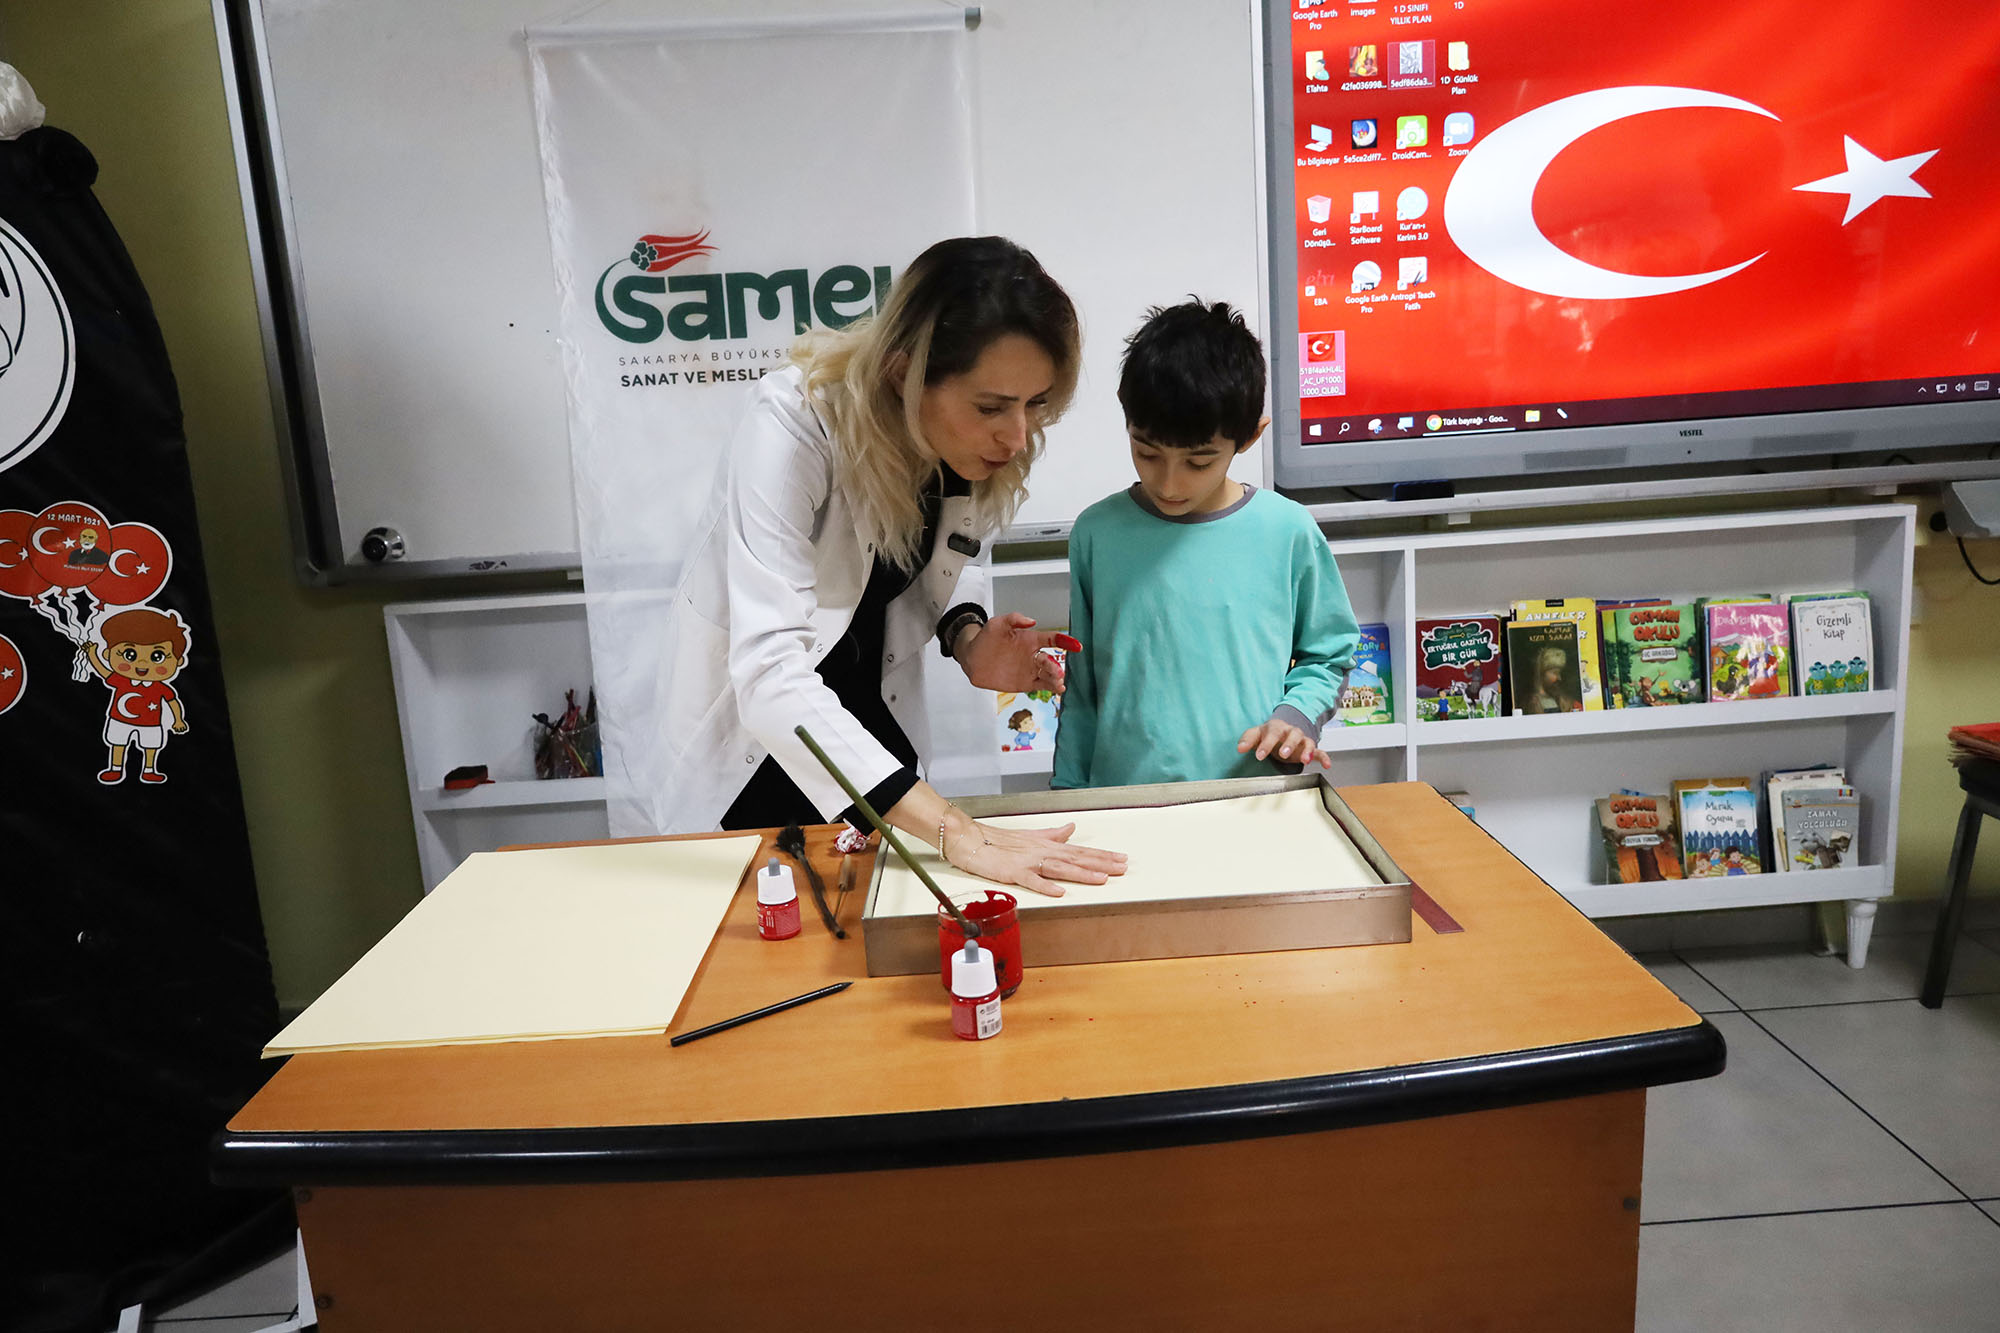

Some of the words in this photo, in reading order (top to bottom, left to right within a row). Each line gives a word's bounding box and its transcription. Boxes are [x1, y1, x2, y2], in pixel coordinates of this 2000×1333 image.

[1399, 5, 1406, 13] D
[1407, 4, 1428, 12] SINIFI
[1293, 10, 1318, 20] Google
[1320, 9, 1338, 18] Earth
[1390, 16, 1412, 25] YILLIK
[1412, 15, 1432, 24] PLAN
[1310, 22, 1322, 31] Pro
[1440, 76, 1450, 84] 1D
[1453, 74, 1478, 84] Günlük
[1306, 84, 1328, 94] ETahta
[1451, 86, 1467, 95] Plan
[1448, 148, 1470, 157] Zoom
[1297, 158, 1306, 167] Bu
[1307, 156, 1340, 167] bilgisayar
[1312, 228, 1327, 237] Geri
[1349, 224, 1383, 234] StarBoard
[1351, 235, 1381, 245] Software
[1397, 233, 1417, 242] Kerim
[1417, 231, 1429, 241] 3.0
[1345, 294, 1370, 304] Google
[1371, 293, 1388, 303] Earth
[1390, 292, 1416, 301] Antropi
[1417, 290, 1436, 299] Teach
[1314, 297, 1328, 306] EBA
[1361, 305, 1373, 314] Pro
[1404, 303, 1421, 311] Fatih
[618, 353, 701, 366] SAKARYA
[620, 371, 678, 388] SANAT
[684, 371, 707, 384] VE
[1442, 417, 1457, 426] Türk
[1458, 416, 1483, 427] bayrağı
[1489, 415, 1508, 423] Goo...
[1679, 429, 1703, 437] VESTEL
[58, 514, 81, 523] MART
[83, 517, 100, 525] 1921
[1630, 609, 1680, 625] ORMAN
[1816, 613, 1852, 628] Gizemli
[1633, 624, 1680, 642] OKULU
[1823, 628, 1845, 641] Kitap
[1427, 641, 1459, 654] ERTUĞRUL
[1442, 651, 1456, 662] BİR
[1459, 649, 1477, 660] GÜN
[1808, 810, 1838, 818] ZAMAN
[1799, 820, 1848, 829] YOLCULUĞU
